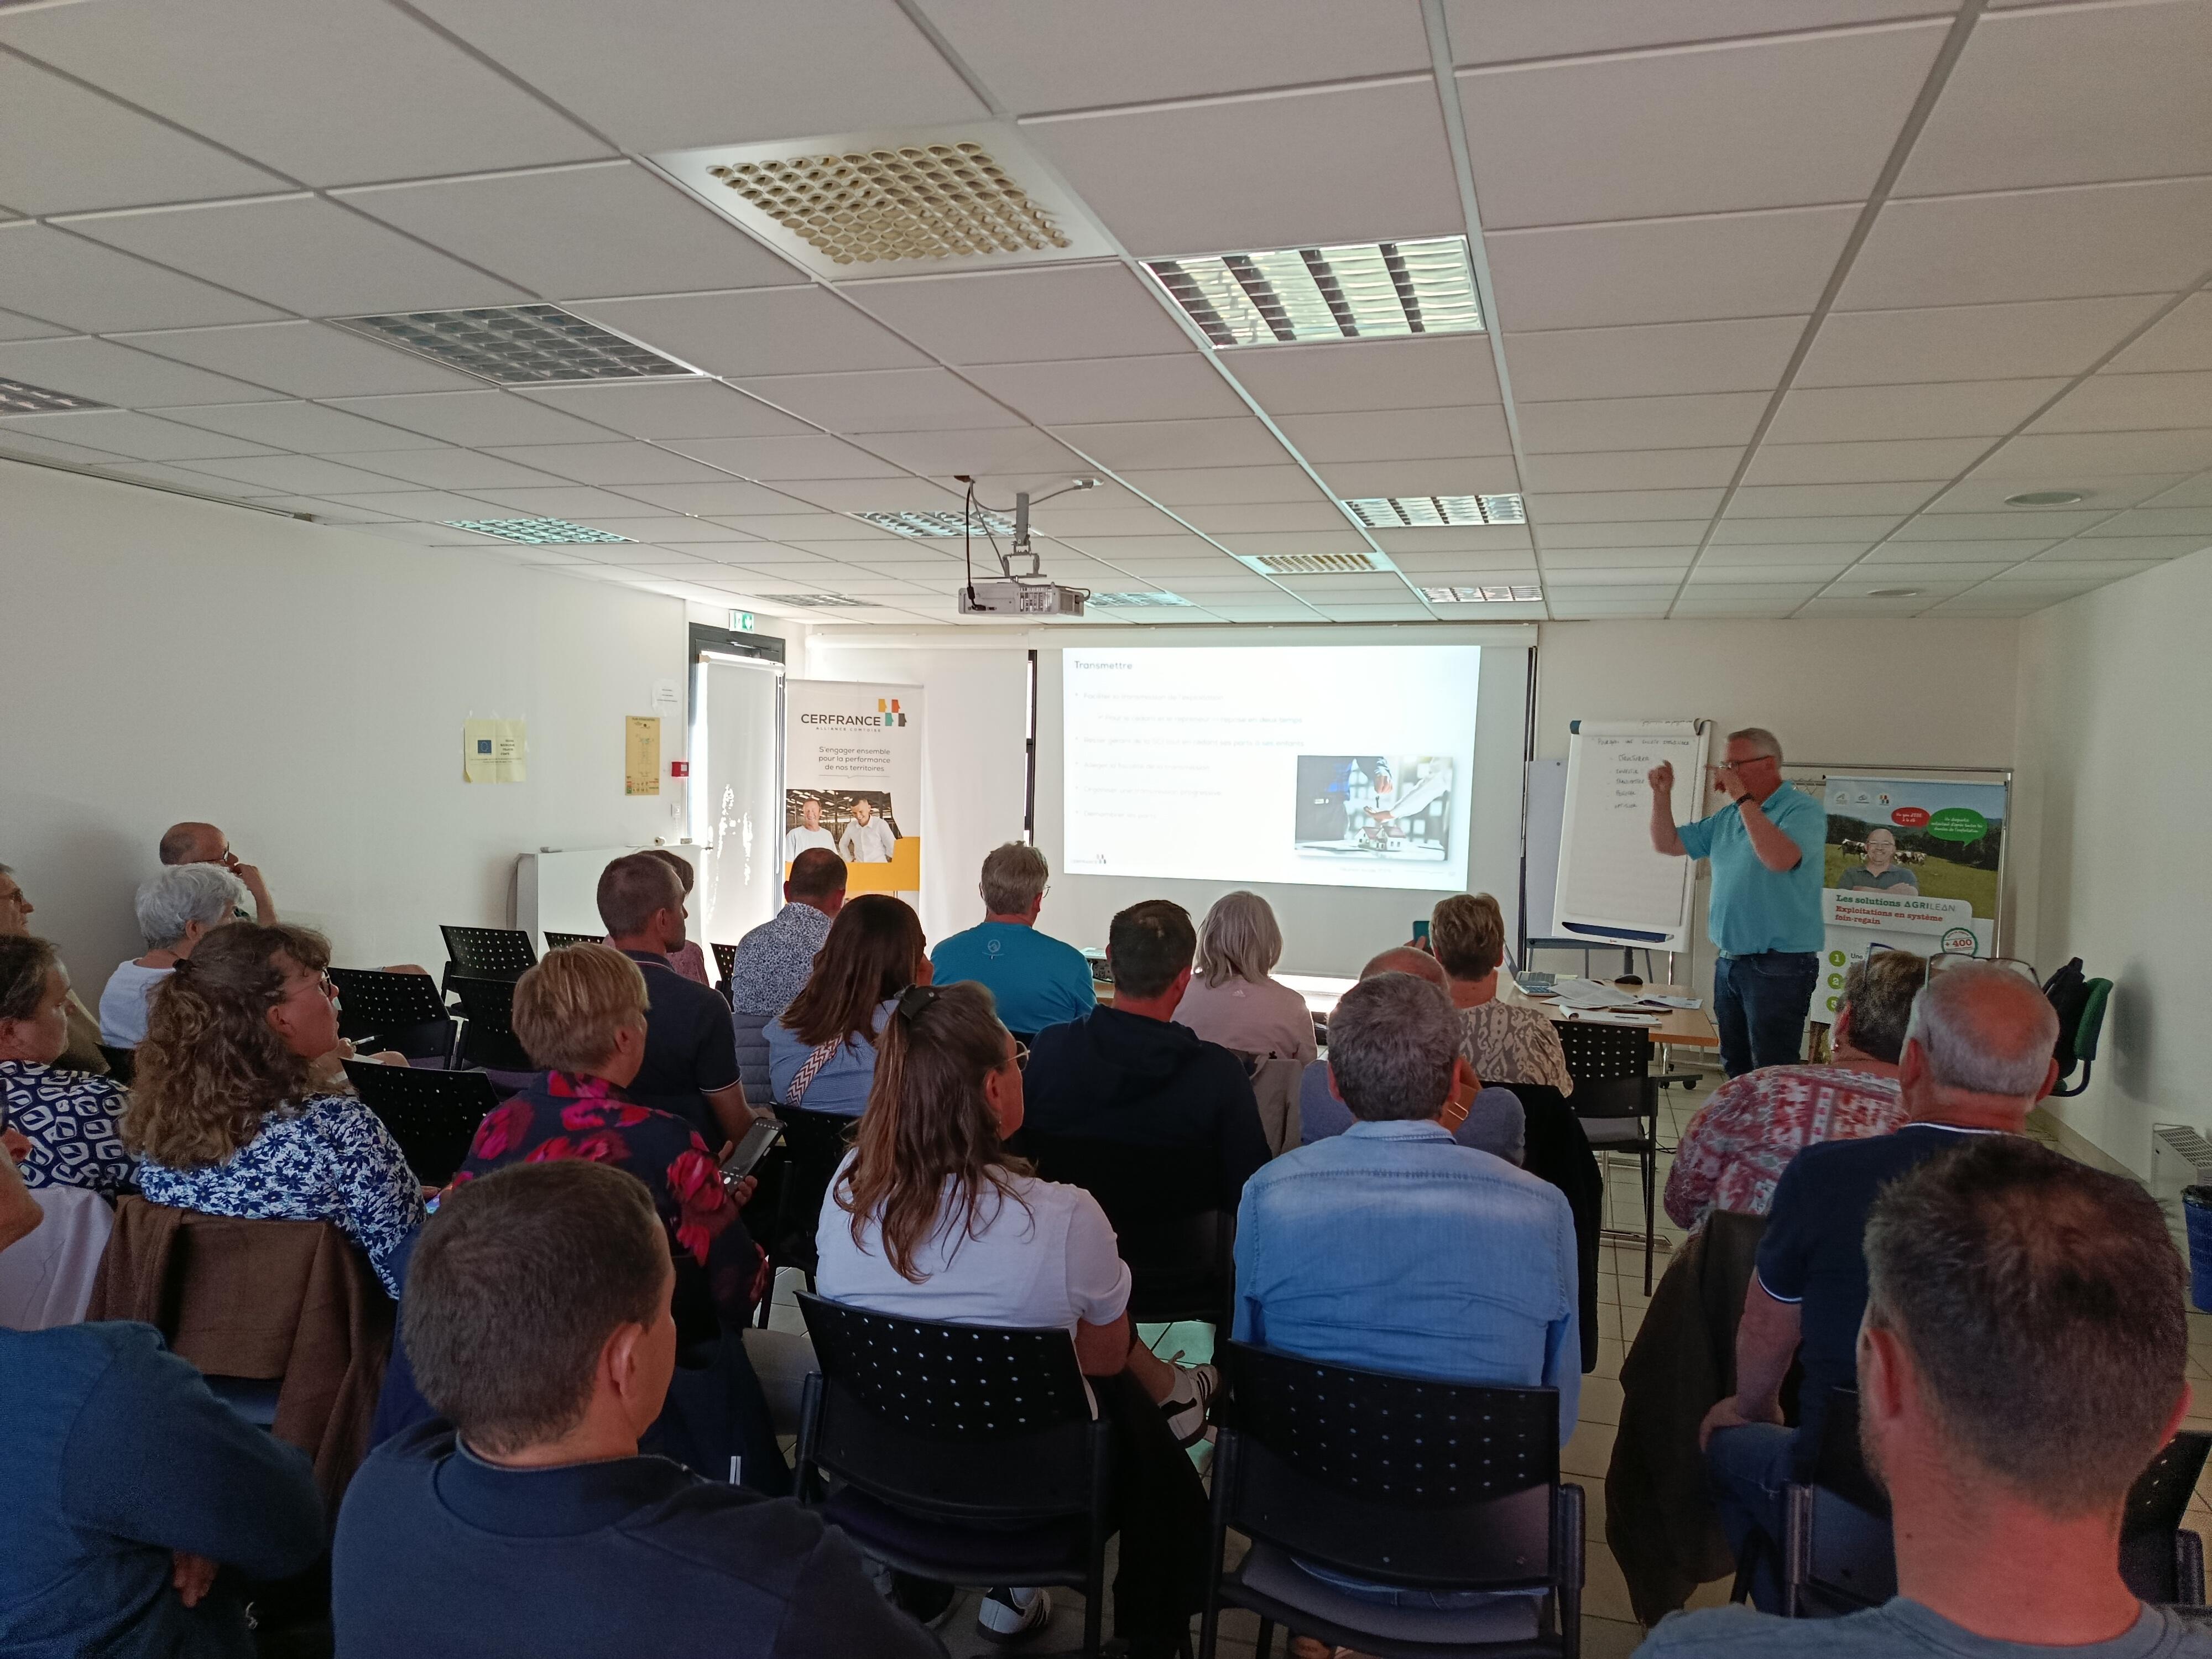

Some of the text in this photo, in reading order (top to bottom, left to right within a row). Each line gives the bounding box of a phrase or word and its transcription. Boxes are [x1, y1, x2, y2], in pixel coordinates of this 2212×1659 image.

[1074, 661, 1133, 669] Transmettre
[801, 714, 880, 726] CERFRANCE
[819, 747, 855, 755] S'engager
[1855, 895, 1901, 907] solutions
[1904, 901, 1956, 912] AGRILEAN
[1835, 914, 1880, 925] foin-regain
[1836, 906, 1892, 917] Exploitations
[1907, 912, 1943, 922] système
[1832, 977, 1839, 985] 2
